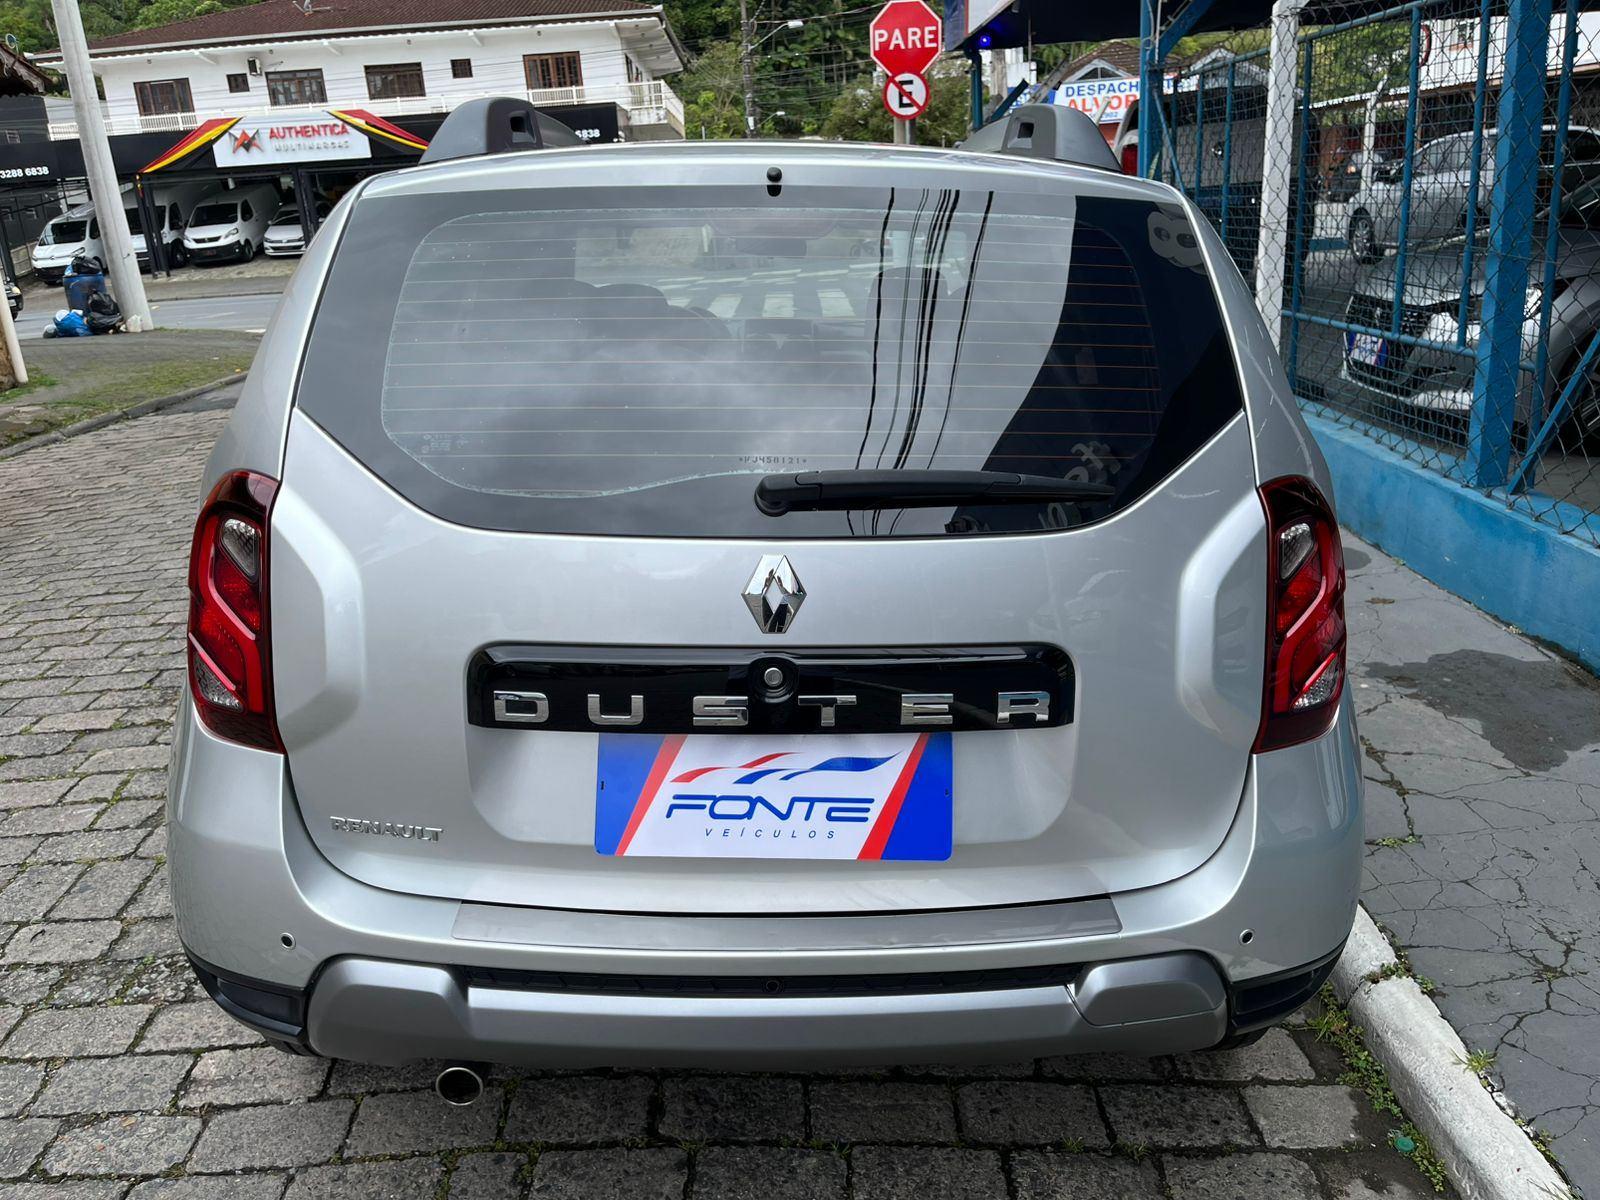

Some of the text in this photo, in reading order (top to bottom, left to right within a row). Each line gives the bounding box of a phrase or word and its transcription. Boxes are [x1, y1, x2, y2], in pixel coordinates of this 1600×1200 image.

[873, 25, 938, 51] PARE
[269, 123, 349, 140] AUTHENTICA
[0, 166, 49, 179] 3288 6838
[493, 690, 1050, 728] DUSTER
[665, 793, 876, 824] FONTE
[330, 815, 444, 842] RENAULT
[704, 825, 836, 839] VEÍCULOS
